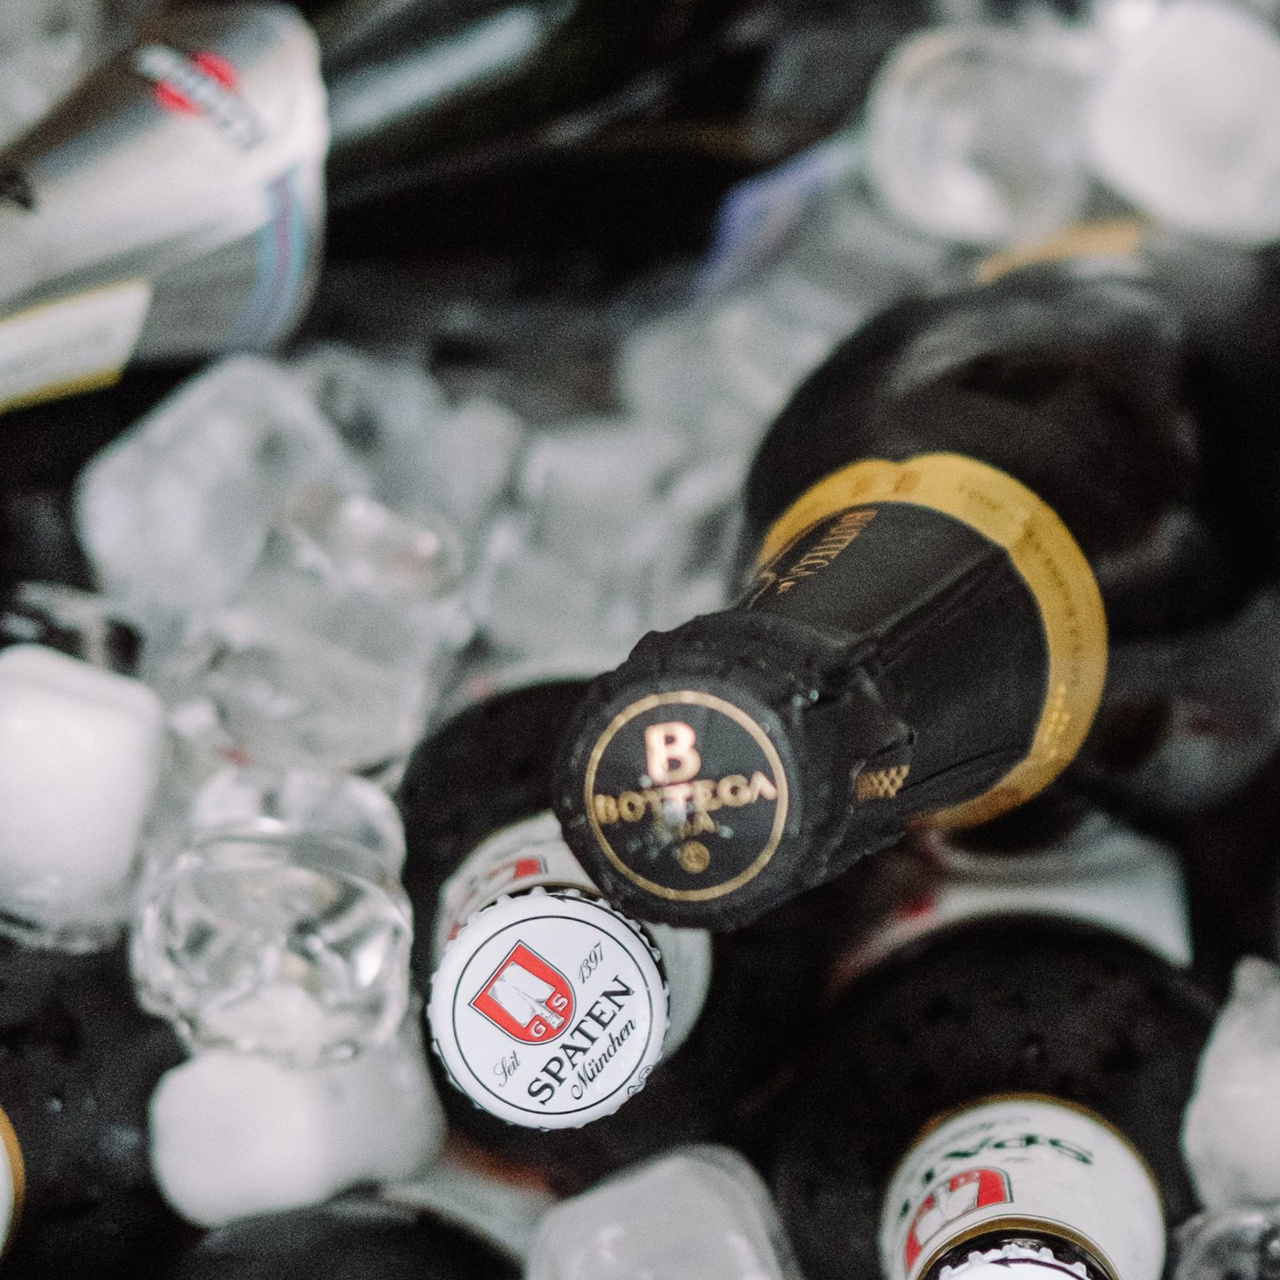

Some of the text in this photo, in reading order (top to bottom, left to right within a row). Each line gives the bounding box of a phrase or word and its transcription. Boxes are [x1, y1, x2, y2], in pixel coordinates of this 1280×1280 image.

[644, 722, 701, 784] B
[494, 941, 604, 1087] Seit 1397
[527, 975, 635, 1105] SPATEN
[571, 1019, 636, 1100] München
